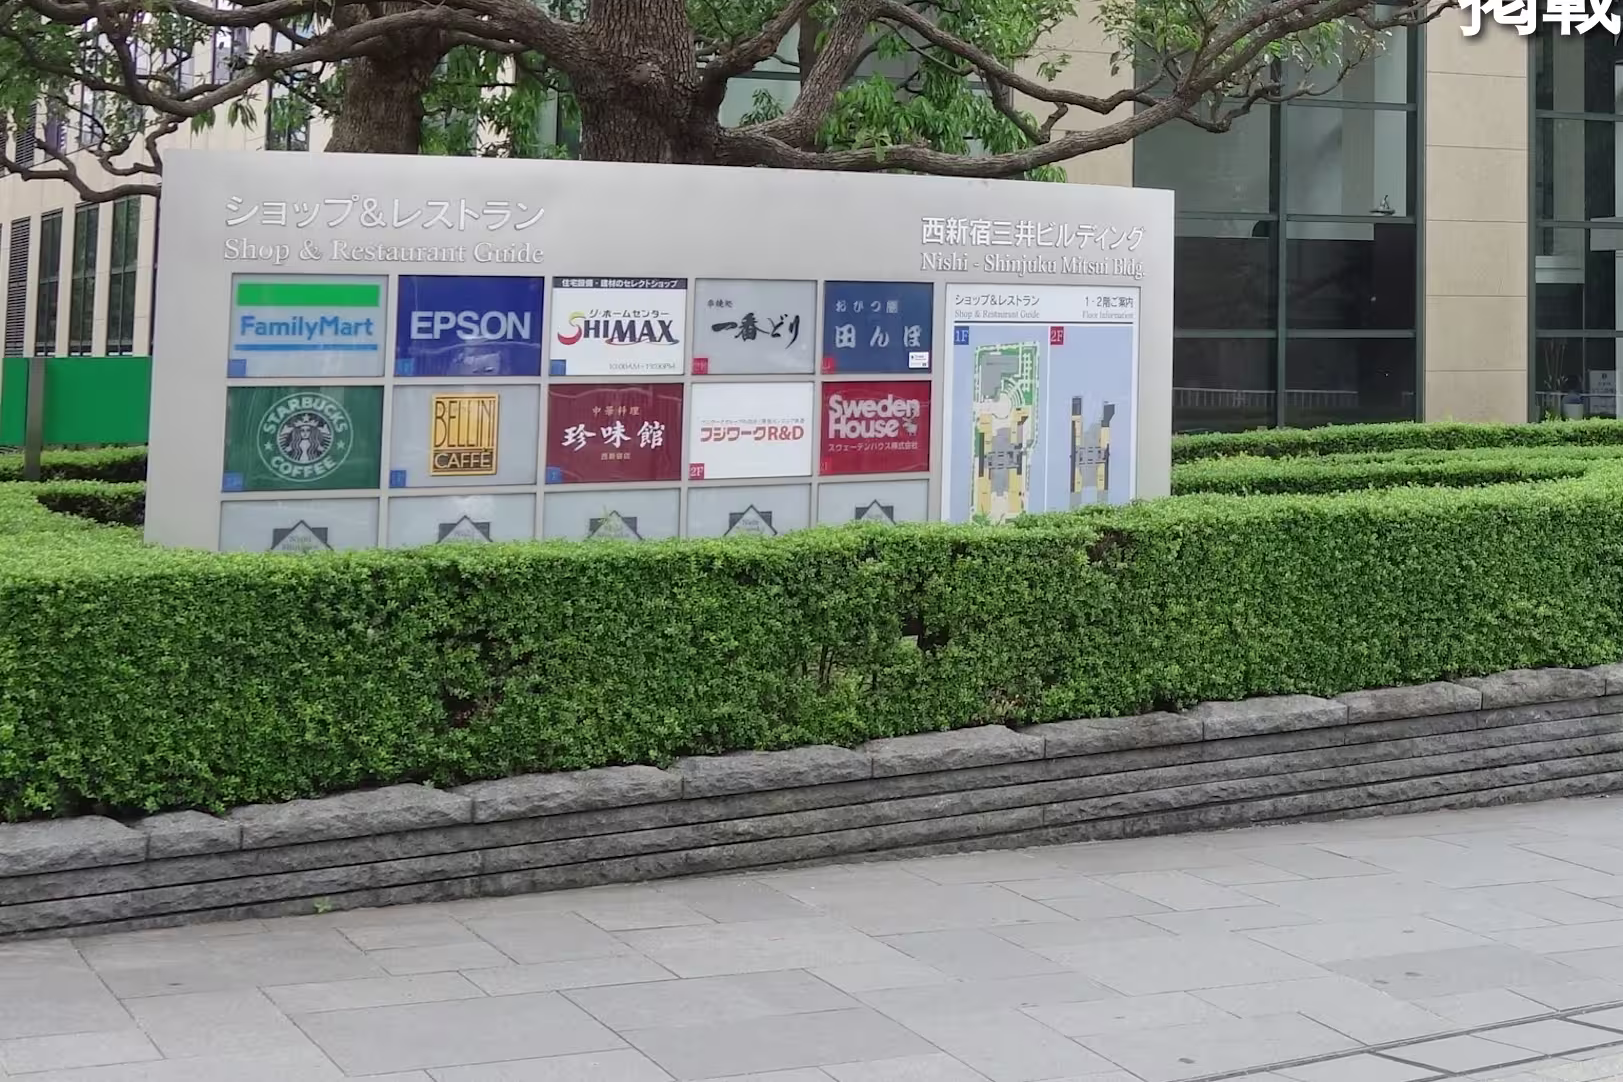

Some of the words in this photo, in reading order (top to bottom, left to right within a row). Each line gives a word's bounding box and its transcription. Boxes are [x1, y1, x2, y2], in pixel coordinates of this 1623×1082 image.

[225, 195, 545, 231] ショップ&レストラン
[921, 217, 1145, 251] 西新宿三井ビルディング
[224, 238, 290, 265] Shop
[300, 239, 322, 260] &
[329, 240, 467, 263] Restaurant
[474, 242, 545, 263] Guide
[920, 252, 969, 272] Nishi
[984, 255, 1057, 277] Shinjuku
[1060, 256, 1109, 276] Mitsui
[1113, 259, 1147, 279] Bldg.
[955, 295, 1040, 307] ショップ&レストラン
[240, 316, 374, 341] FamilyMart
[410, 311, 531, 340] EPSON
[557, 311, 677, 345] SHIMAX
[711, 312, 800, 349] 一番どり
[955, 330, 969, 342] 1F
[1051, 330, 1064, 342] 2F
[263, 397, 348, 434] STARBUCKS
[829, 394, 920, 418] Sweden
[434, 400, 496, 447] BELLINI
[561, 420, 666, 452] 珍味館
[700, 425, 805, 442] フジワークR&D
[828, 416, 900, 439] House
[271, 455, 337, 478] COFFEE
